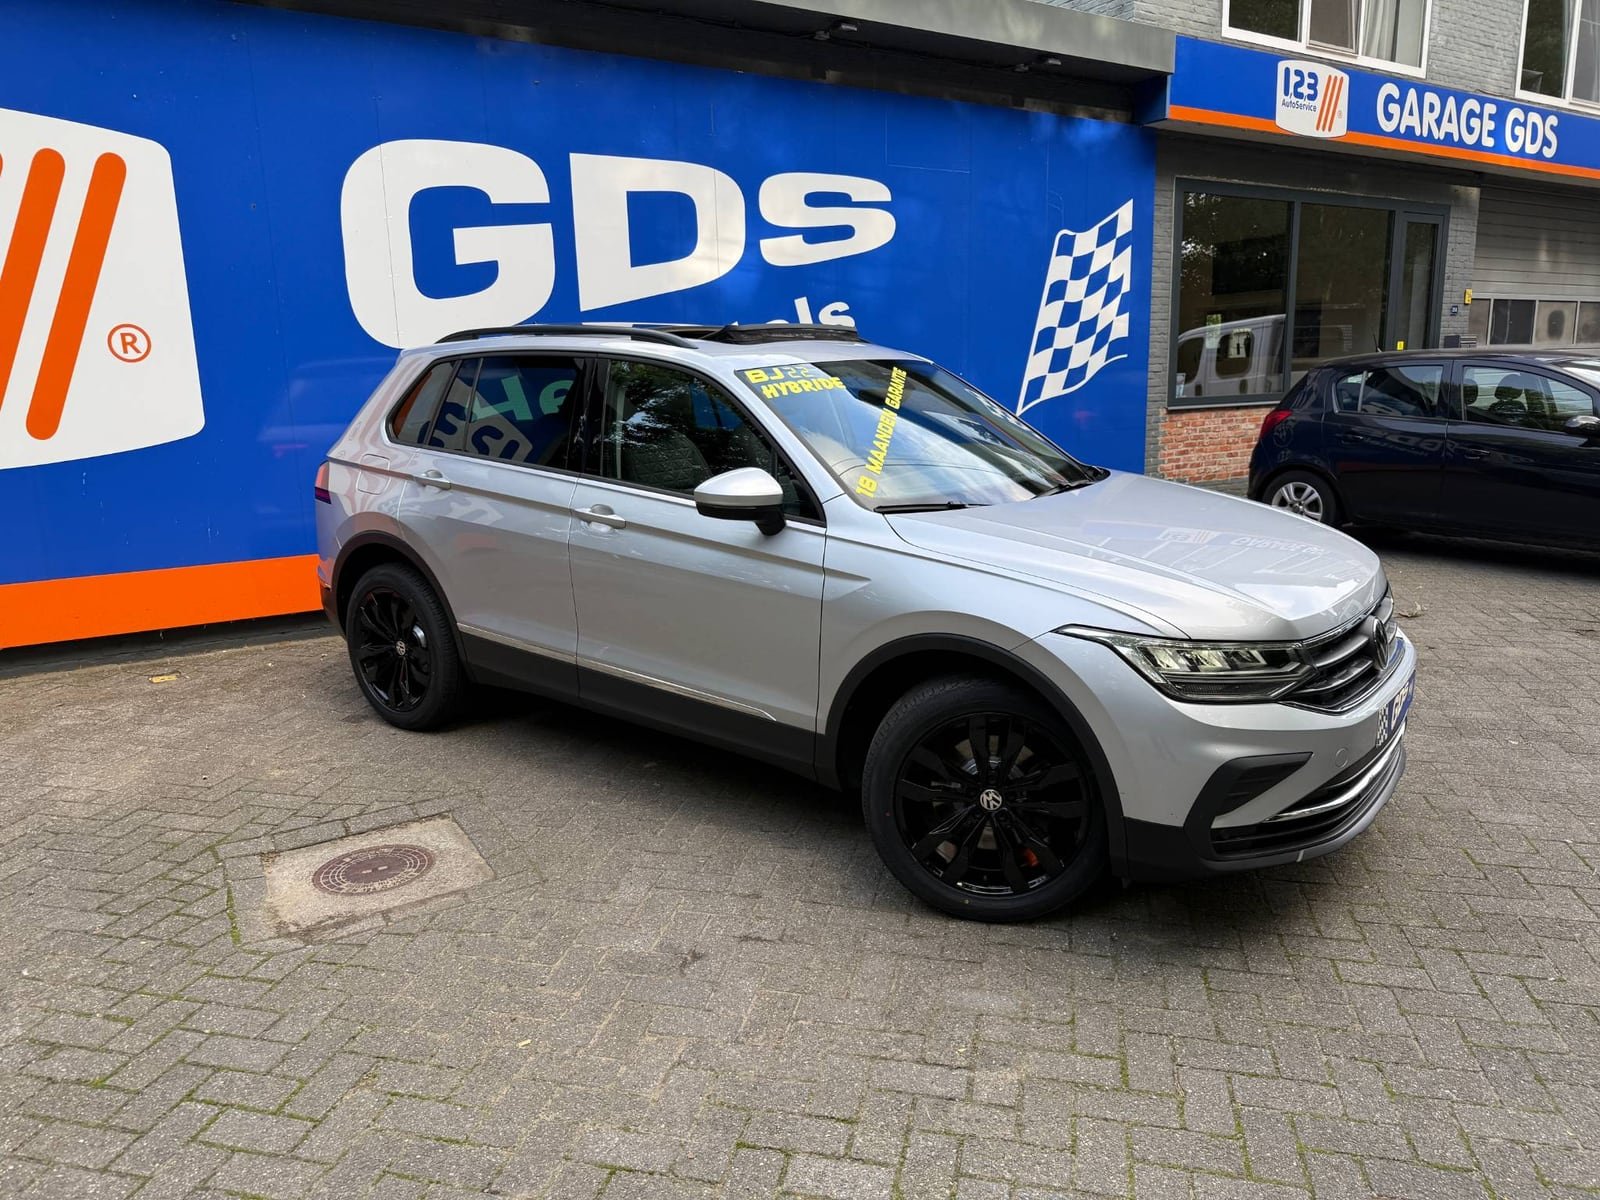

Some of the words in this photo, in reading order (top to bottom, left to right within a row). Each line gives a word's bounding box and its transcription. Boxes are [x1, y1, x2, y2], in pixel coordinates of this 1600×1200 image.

[1281, 98, 1317, 112] AutoService
[1376, 82, 1497, 148] GARAGE
[1504, 107, 1559, 158] GDS
[341, 139, 896, 348] GDS
[744, 367, 785, 384] BJ
[760, 376, 846, 399] HYBRIDE
[864, 407, 898, 475] MAANDEN
[856, 476, 878, 498] 18
